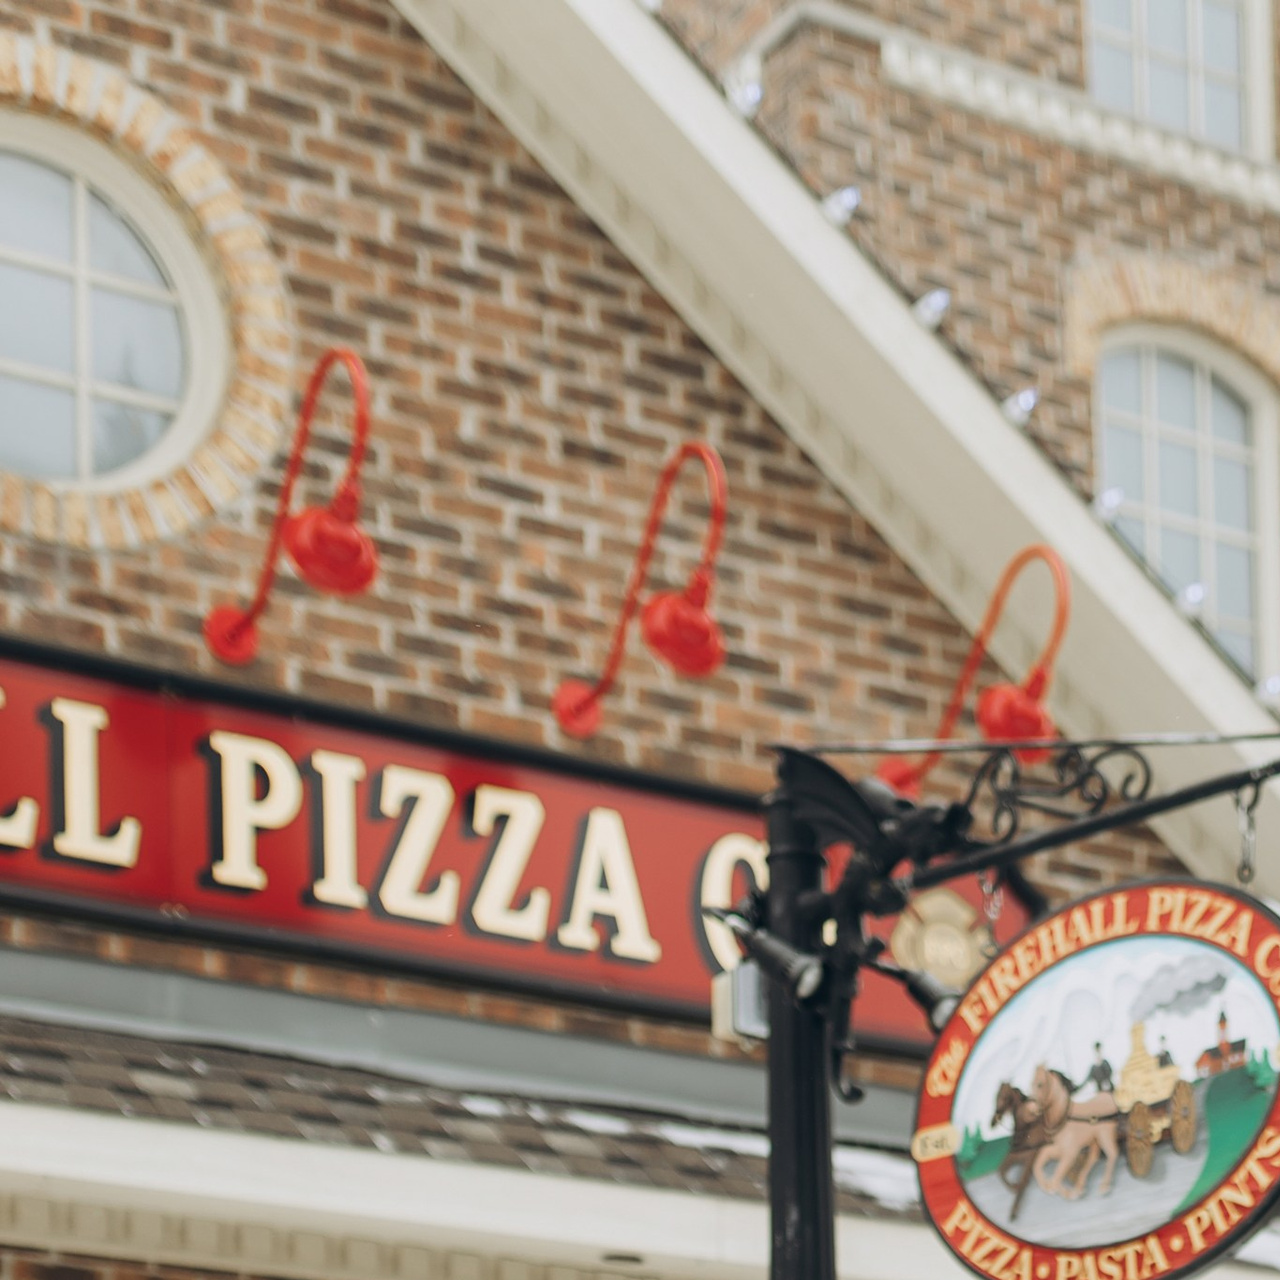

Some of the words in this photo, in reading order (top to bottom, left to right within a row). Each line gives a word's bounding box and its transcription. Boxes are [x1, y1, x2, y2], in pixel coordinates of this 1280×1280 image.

[208, 730, 662, 964] PIZZA
[959, 892, 1139, 1036] FIREHALL
[1147, 888, 1256, 958] PIZZA
